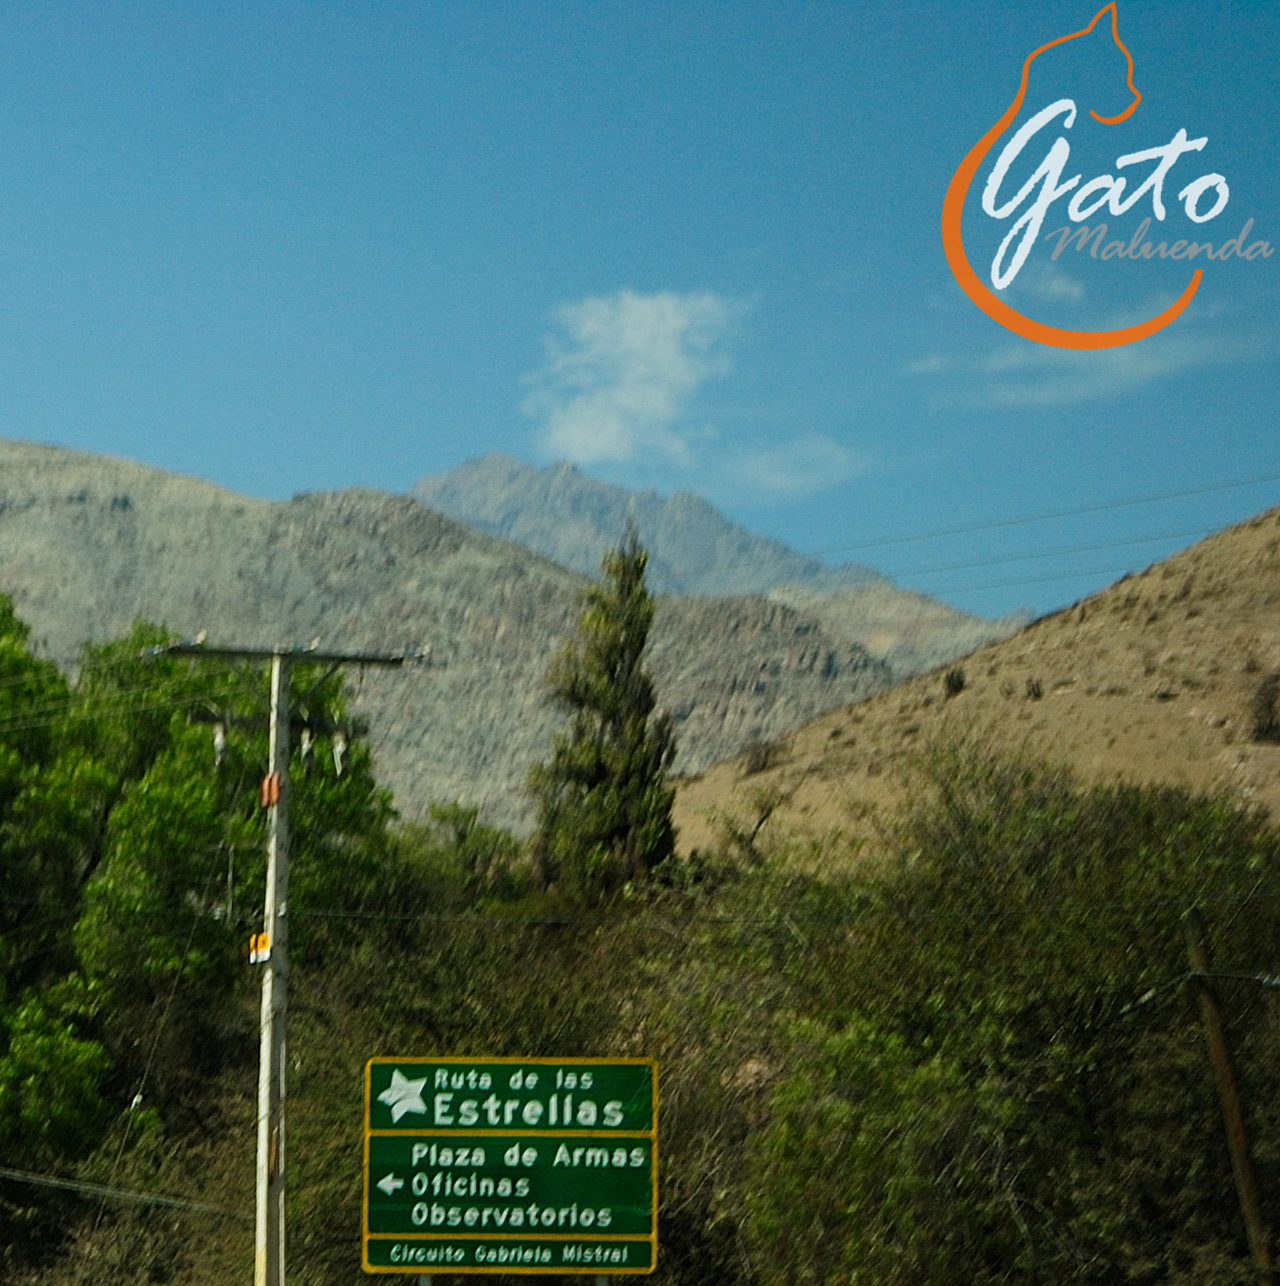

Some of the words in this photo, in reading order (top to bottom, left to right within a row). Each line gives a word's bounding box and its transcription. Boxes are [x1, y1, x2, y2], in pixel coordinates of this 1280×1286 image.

[434, 1068, 492, 1090] Ruta
[509, 1068, 539, 1090] de
[555, 1068, 594, 1090] las
[434, 1092, 625, 1127] Estrellas
[411, 1142, 486, 1167] Plaza
[503, 1142, 538, 1167] de
[552, 1142, 645, 1168] Armas
[411, 1171, 530, 1197] Oficinas
[411, 1201, 613, 1227] Observatorios
[390, 1244, 465, 1263] Circuito
[474, 1244, 552, 1263] Gabriela
[561, 1244, 629, 1263] Mistral
